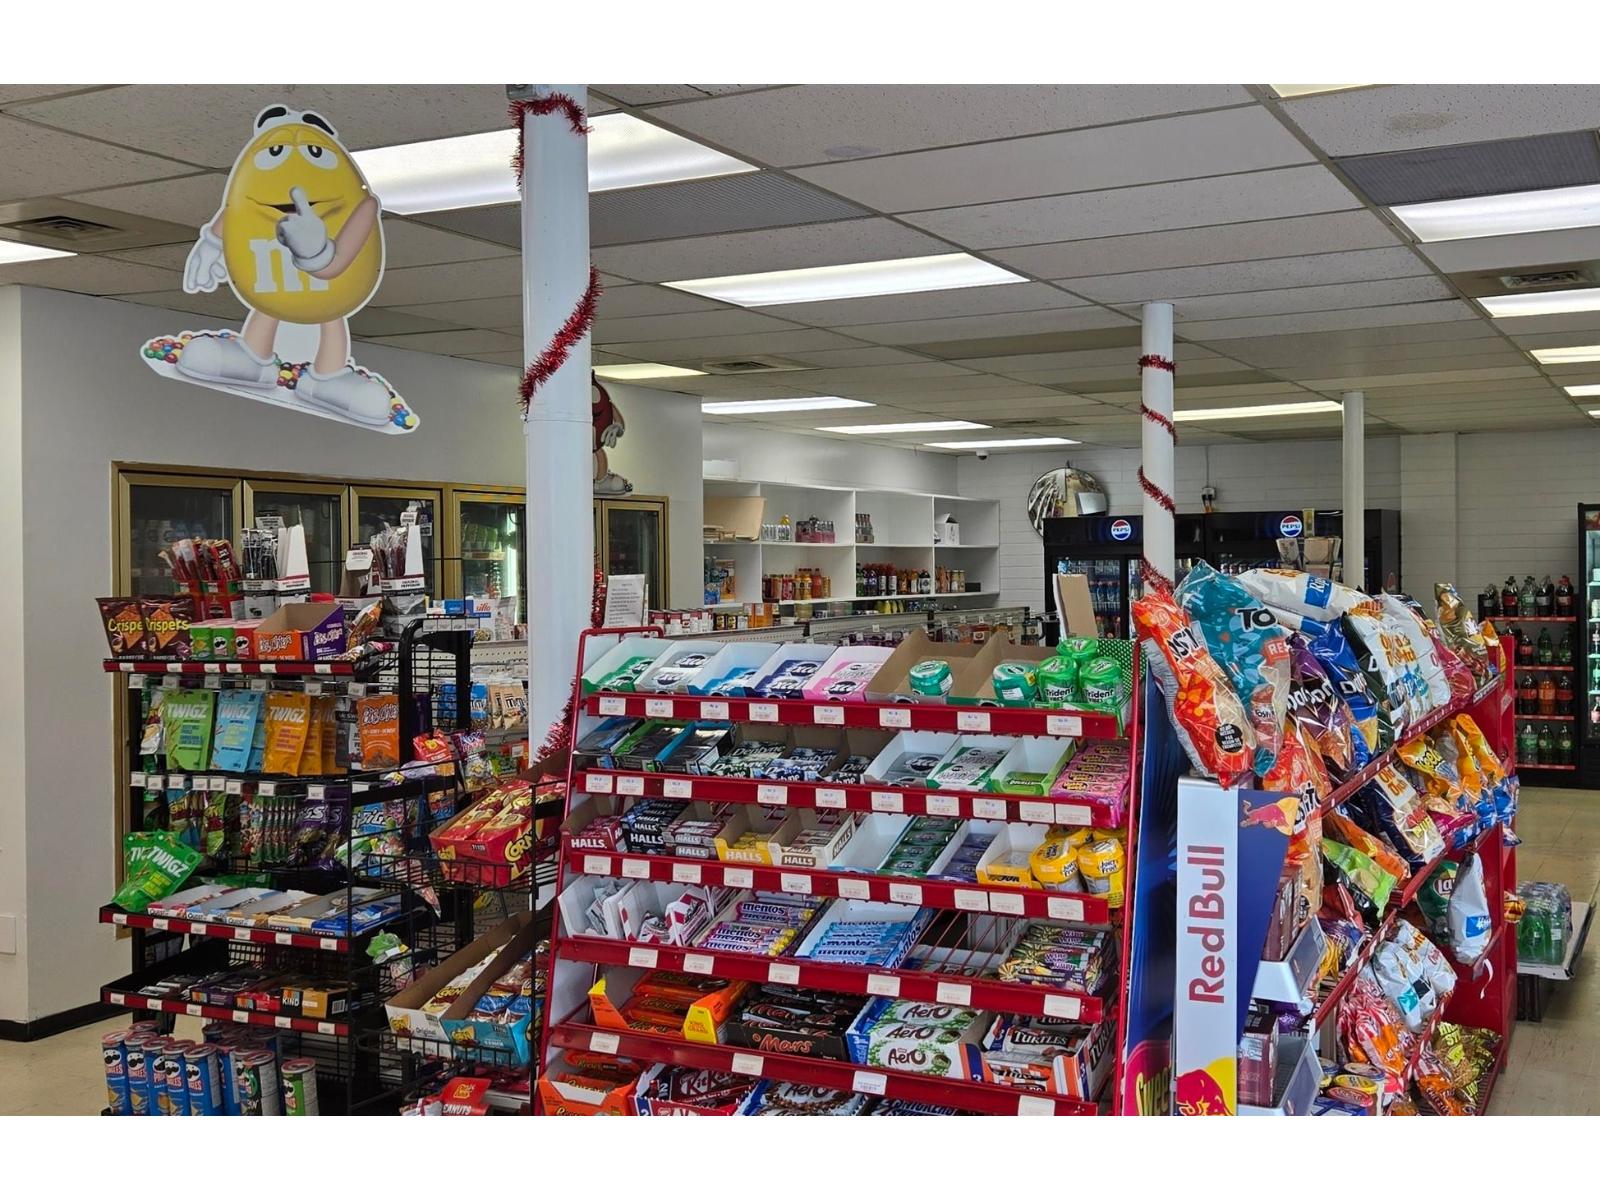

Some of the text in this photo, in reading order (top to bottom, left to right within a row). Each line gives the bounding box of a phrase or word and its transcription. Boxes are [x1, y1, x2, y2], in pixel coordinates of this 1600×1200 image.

[108, 618, 143, 634] Crispe
[1044, 686, 1074, 697] Trident
[1084, 688, 1114, 699] Trident
[167, 703, 208, 719] TWIGZ
[217, 703, 251, 720] TWIGZ
[270, 705, 306, 723] TWIGZ
[634, 822, 658, 832] HALLS
[571, 838, 607, 849] HALLS
[630, 833, 664, 845] HALLS
[676, 835, 699, 843] HALLS
[678, 847, 707, 857] HALLS
[725, 851, 764, 863] HALLS
[147, 845, 189, 879] TWIGZ
[783, 856, 814, 866] HALLS
[1436, 878, 1453, 894] La
[742, 903, 786, 914] mentos
[228, 917, 245, 926] Quest
[1187, 845, 1226, 1004] Red Bull
[717, 927, 762, 939] mentos
[705, 942, 749, 951] mentos
[892, 921, 922, 970] mentos
[282, 997, 300, 1007] KIND
[903, 1003, 952, 1020] Aero
[415, 1026, 437, 1037] Original
[886, 1026, 936, 1040] Aero
[759, 1033, 813, 1053] Mars
[1013, 1031, 1068, 1046] TURTLES
[887, 1048, 927, 1066] Aero
[784, 1084, 831, 1097] Aero
